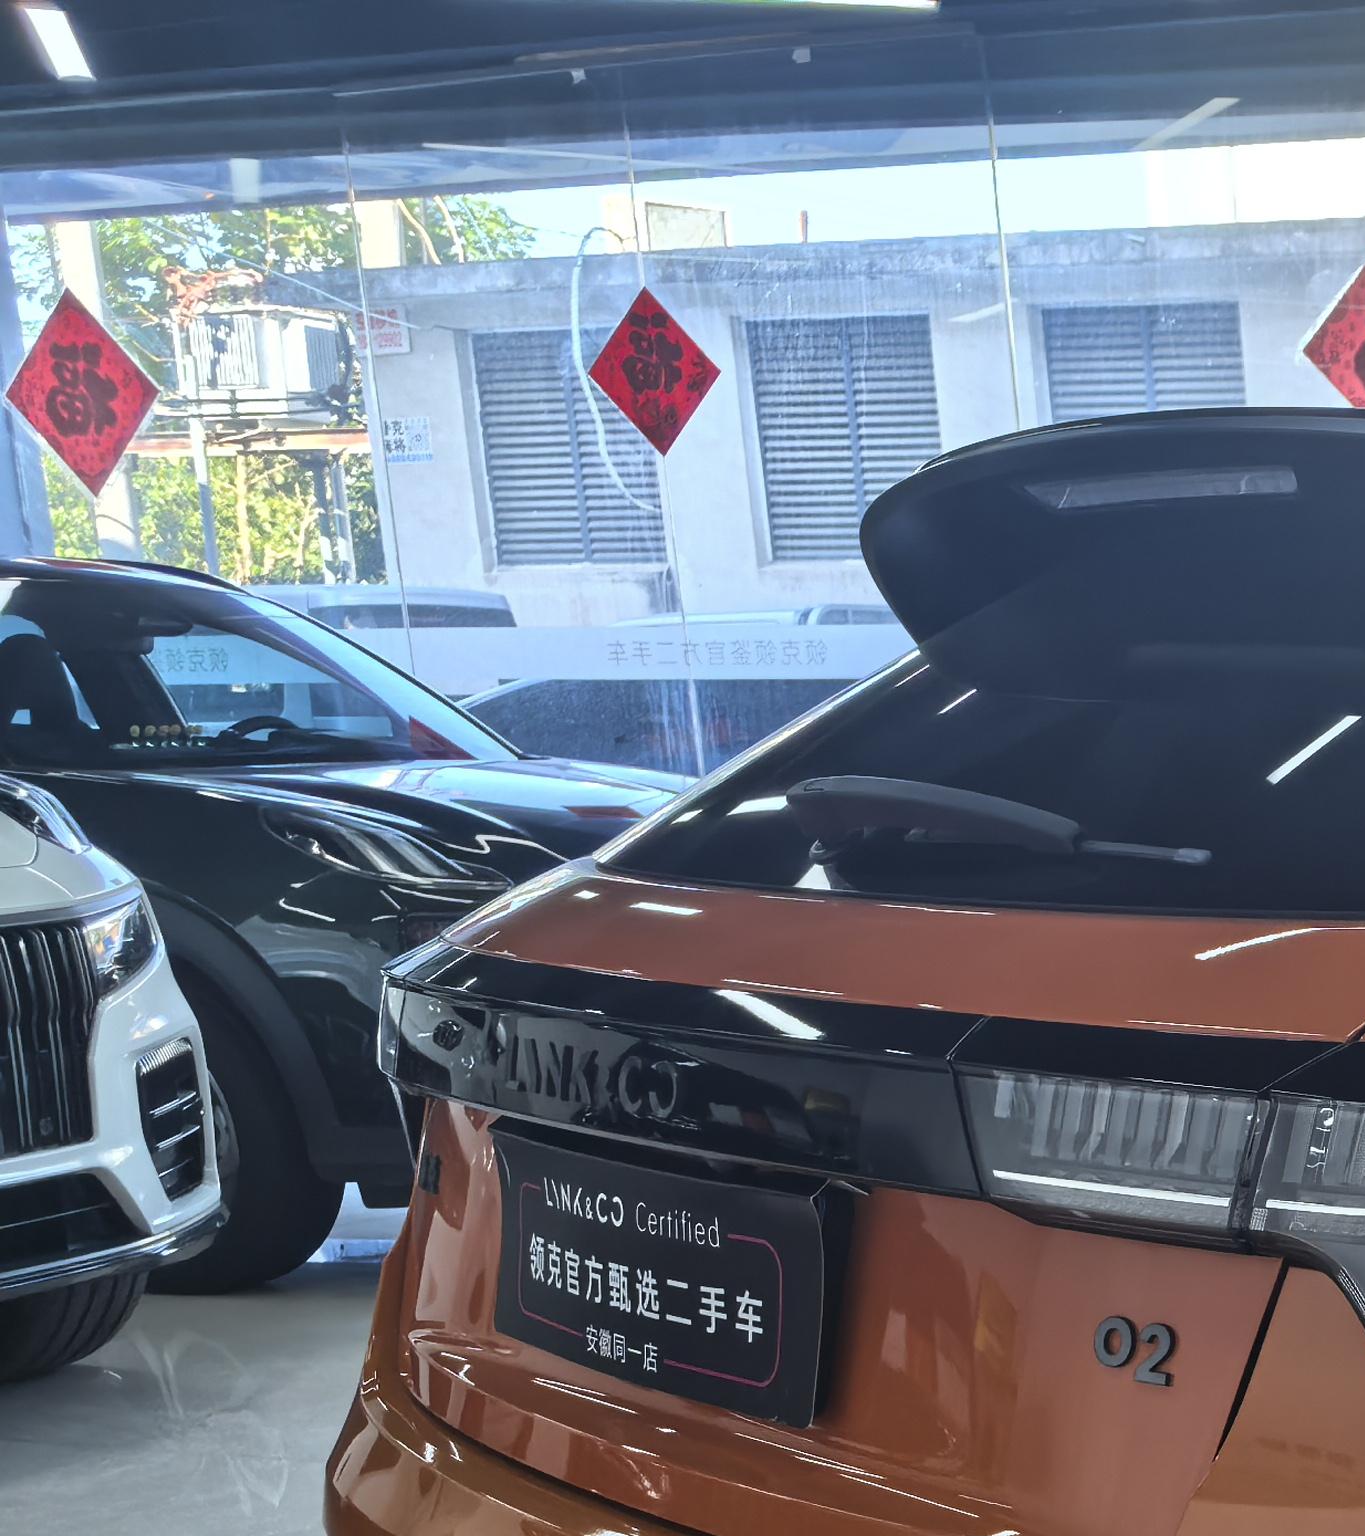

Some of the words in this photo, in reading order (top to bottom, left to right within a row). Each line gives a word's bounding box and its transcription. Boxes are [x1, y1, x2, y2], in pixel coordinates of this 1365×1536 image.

[635, 1202, 721, 1248] Certified
[529, 1232, 764, 1344] 领克官方甄选二手车
[585, 1325, 658, 1374] 安徽同一店
